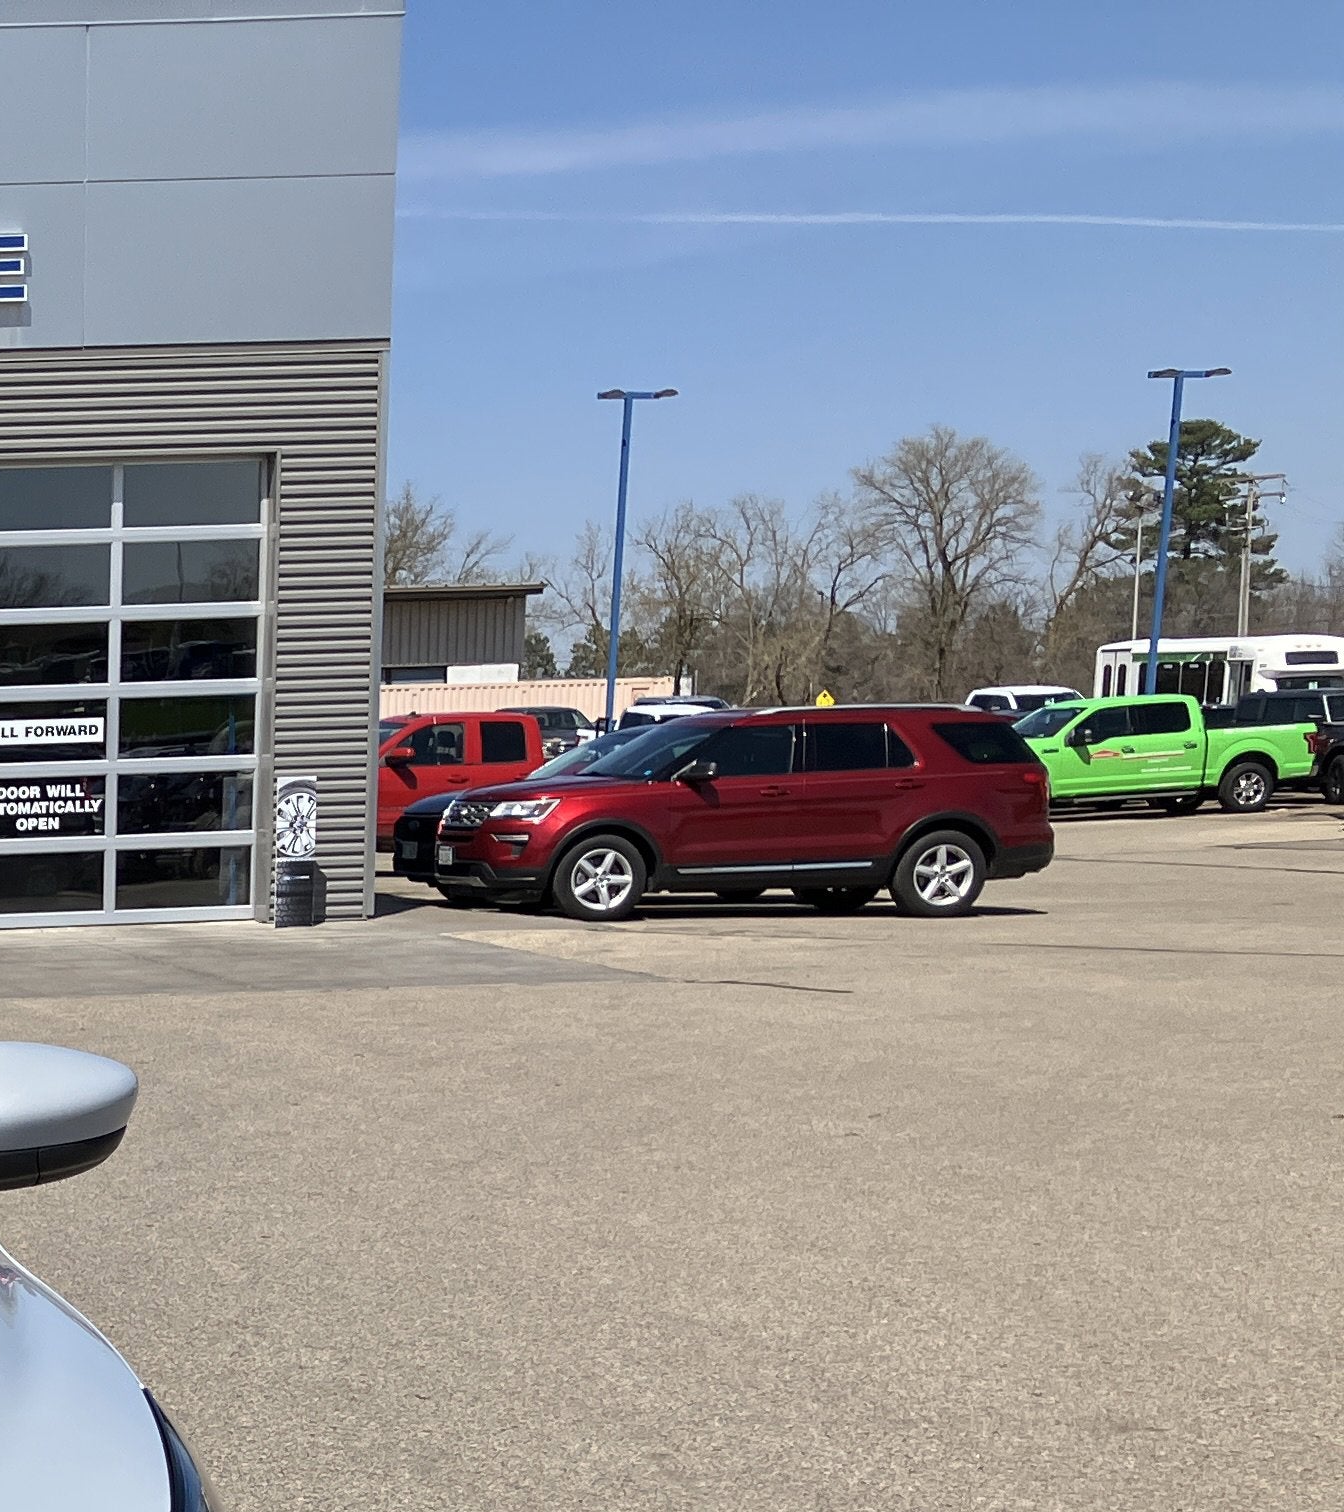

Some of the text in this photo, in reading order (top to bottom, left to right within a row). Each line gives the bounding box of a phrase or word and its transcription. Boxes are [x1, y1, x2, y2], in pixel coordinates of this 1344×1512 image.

[25, 724, 99, 737] FORWARD
[46, 783, 85, 798] WILL
[15, 816, 60, 831] OPEN
